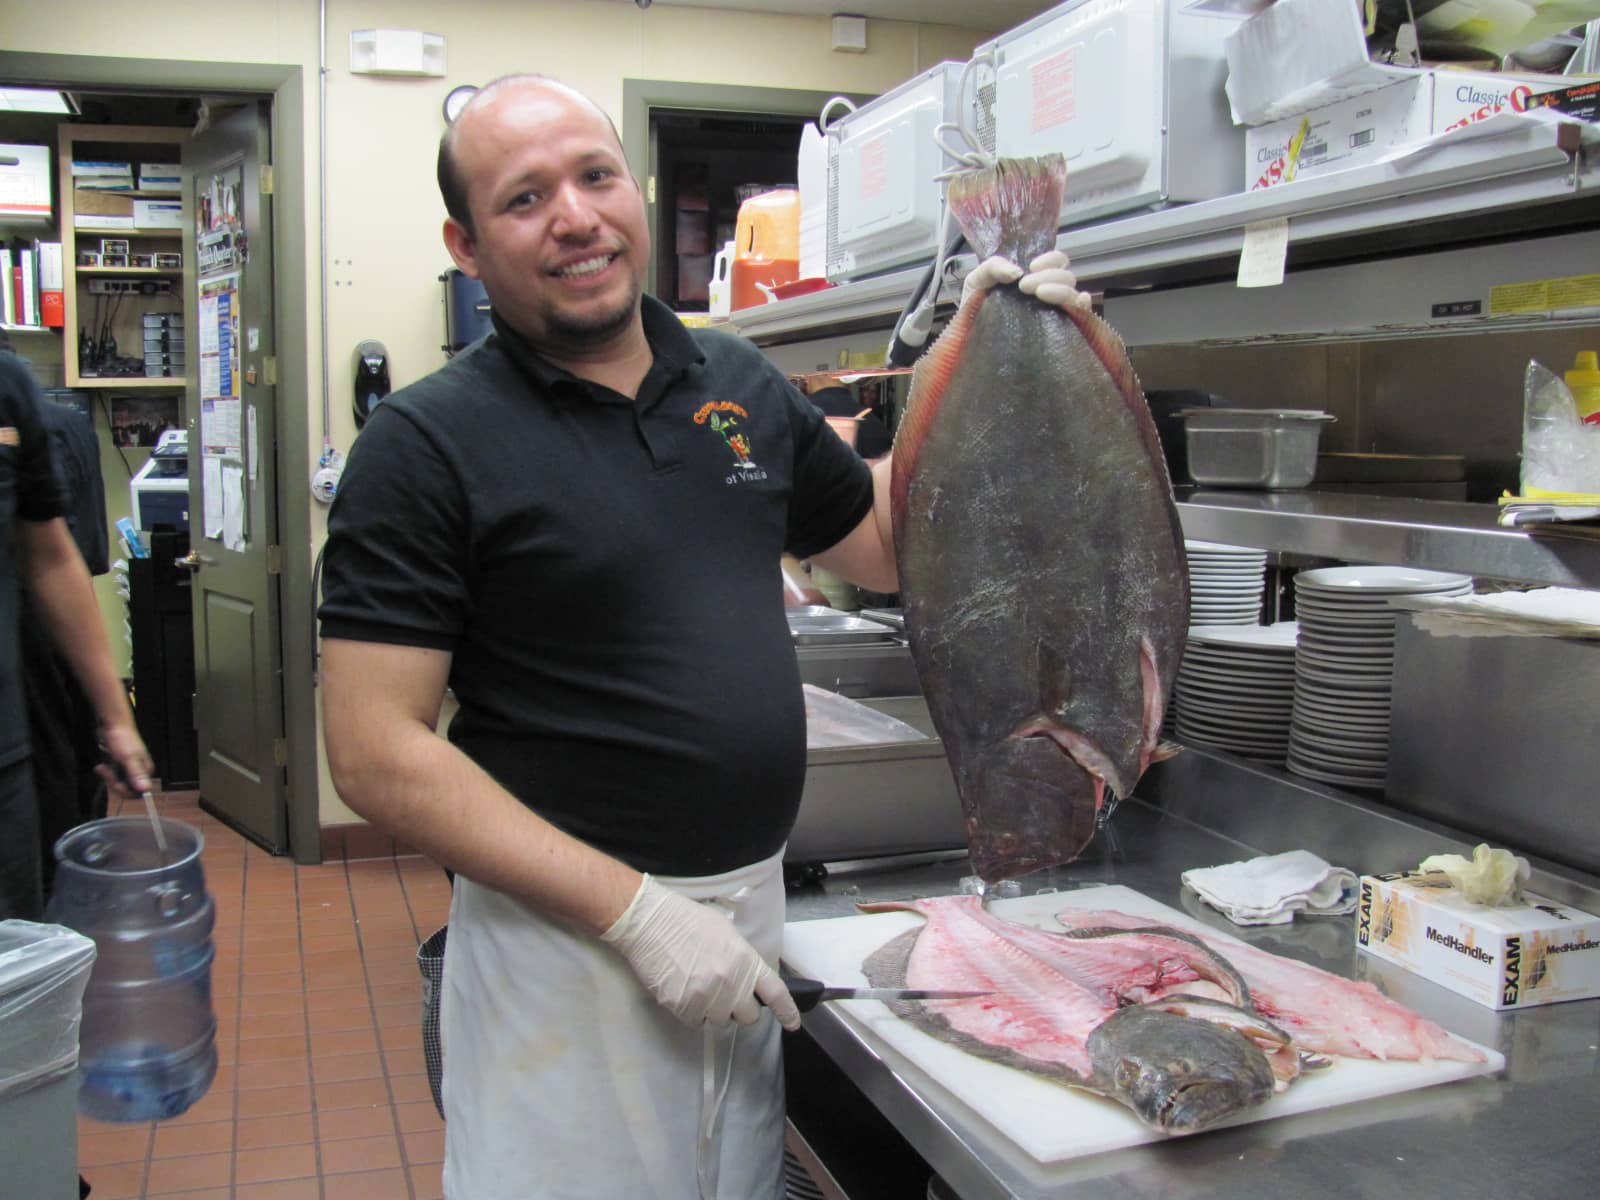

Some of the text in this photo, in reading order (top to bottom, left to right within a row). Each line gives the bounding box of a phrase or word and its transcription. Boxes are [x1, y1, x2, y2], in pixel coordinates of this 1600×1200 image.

[1456, 85, 1506, 106] Classic
[1257, 144, 1285, 163] Classic
[1359, 883, 1372, 947] EXAM
[1426, 926, 1495, 965] MedHandler
[1546, 940, 1600, 955] MedHandler
[1502, 937, 1521, 1006] EXAM
